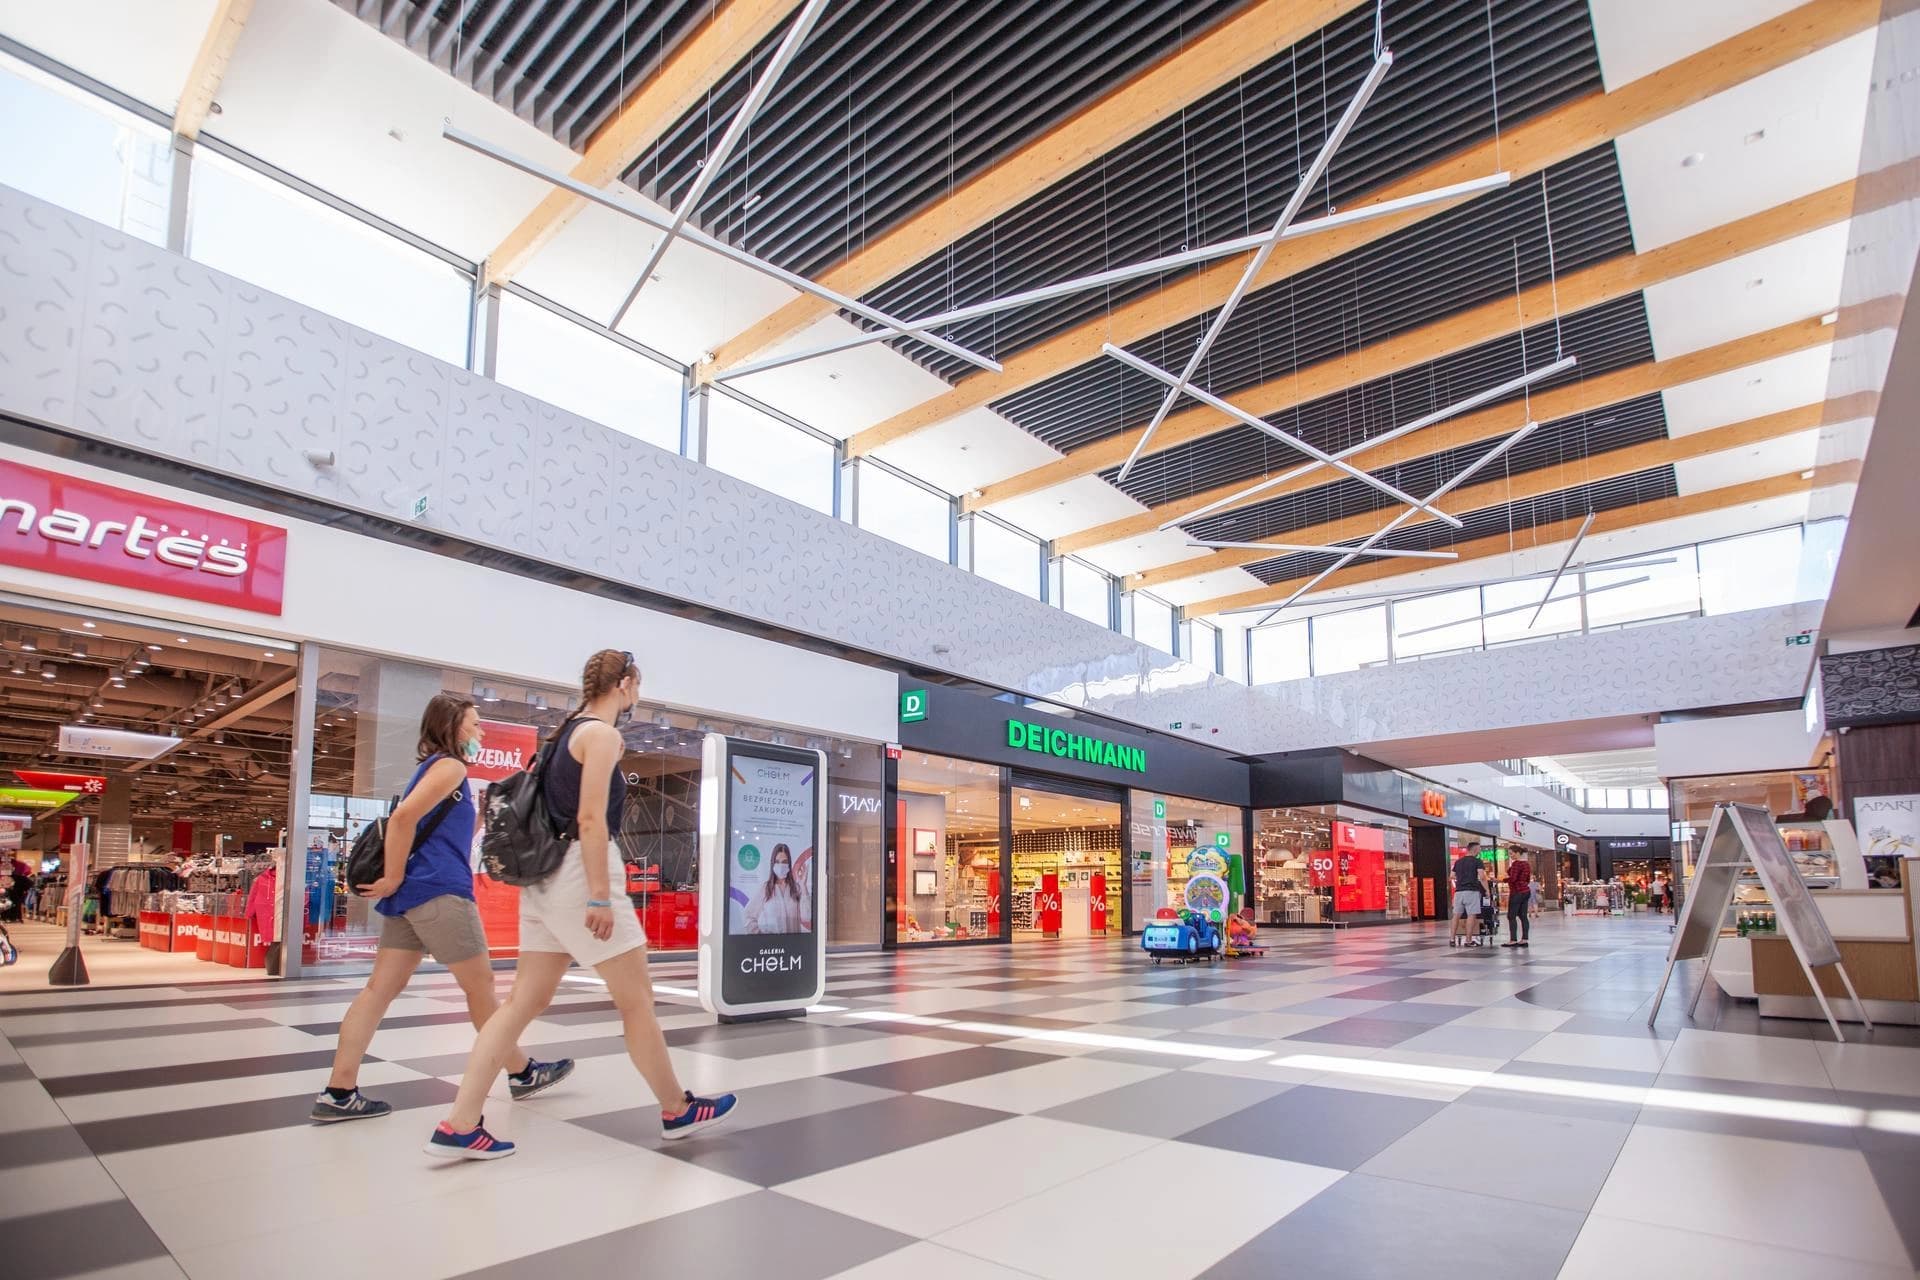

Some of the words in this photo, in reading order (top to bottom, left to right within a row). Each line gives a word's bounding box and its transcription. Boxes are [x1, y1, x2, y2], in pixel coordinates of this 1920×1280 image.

[906, 695, 920, 712] D
[1007, 719, 1146, 773] DEICHMANN
[758, 786, 790, 797] ZASADY
[743, 794, 804, 808] BEZPIECZNYCH
[1860, 800, 1917, 813] APART
[753, 805, 795, 816] ZAKUPÓW
[1217, 834, 1229, 846] D
[1042, 893, 1058, 910] %
[1090, 894, 1105, 912] %
[759, 947, 785, 955] GALERIA
